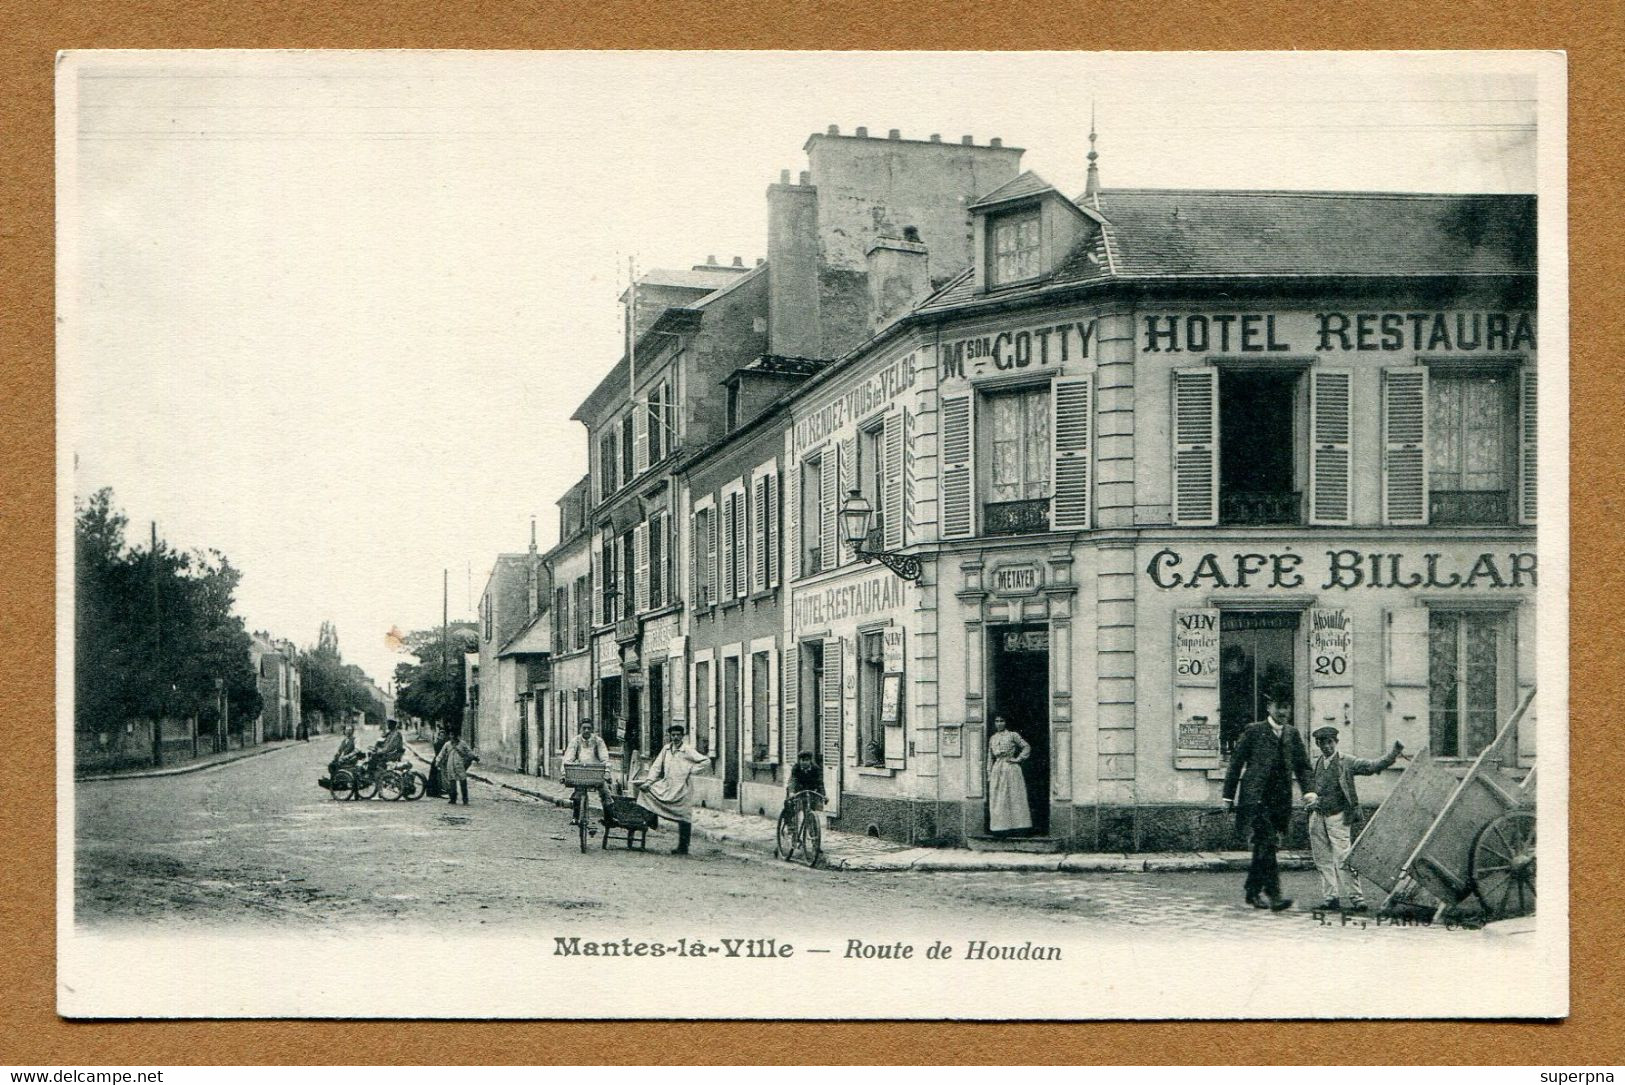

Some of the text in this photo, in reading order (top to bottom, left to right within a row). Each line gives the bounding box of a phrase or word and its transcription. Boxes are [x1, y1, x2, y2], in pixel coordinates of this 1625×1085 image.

[1142, 312, 1537, 353] HOTEL RESTAURA
[808, 380, 873, 446] RENDEZ-VOUS
[1147, 547, 1304, 590] CAFÉ
[1179, 614, 1216, 630] VIN
